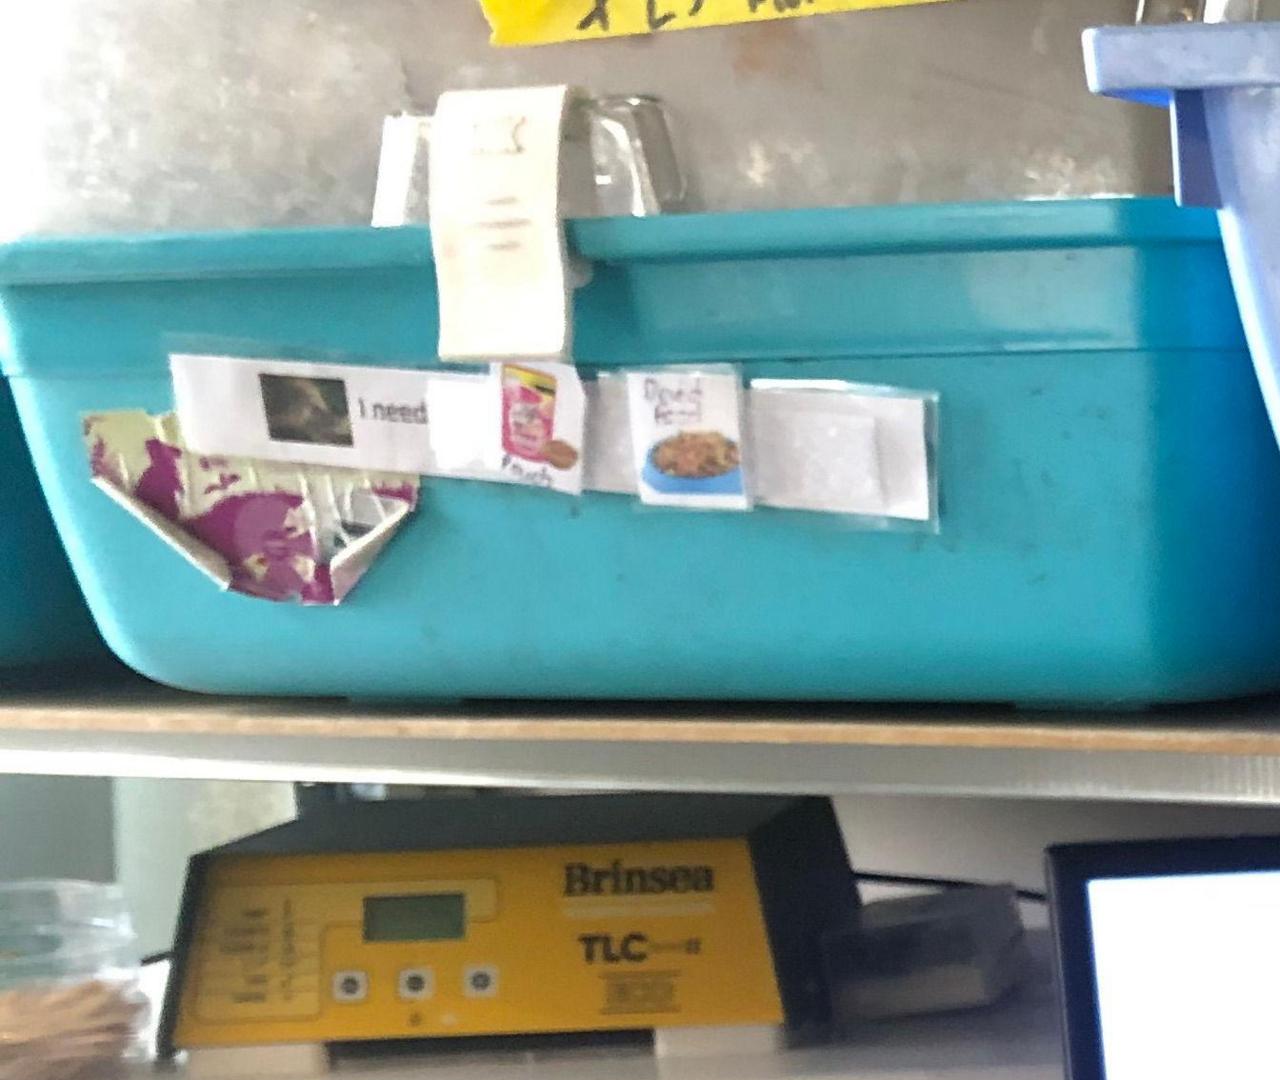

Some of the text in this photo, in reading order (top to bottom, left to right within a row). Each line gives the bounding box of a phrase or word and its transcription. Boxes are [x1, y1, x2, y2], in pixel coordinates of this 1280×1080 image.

[373, 401, 428, 425] need
[564, 859, 715, 896] Brinsea
[578, 932, 648, 965] TLC
